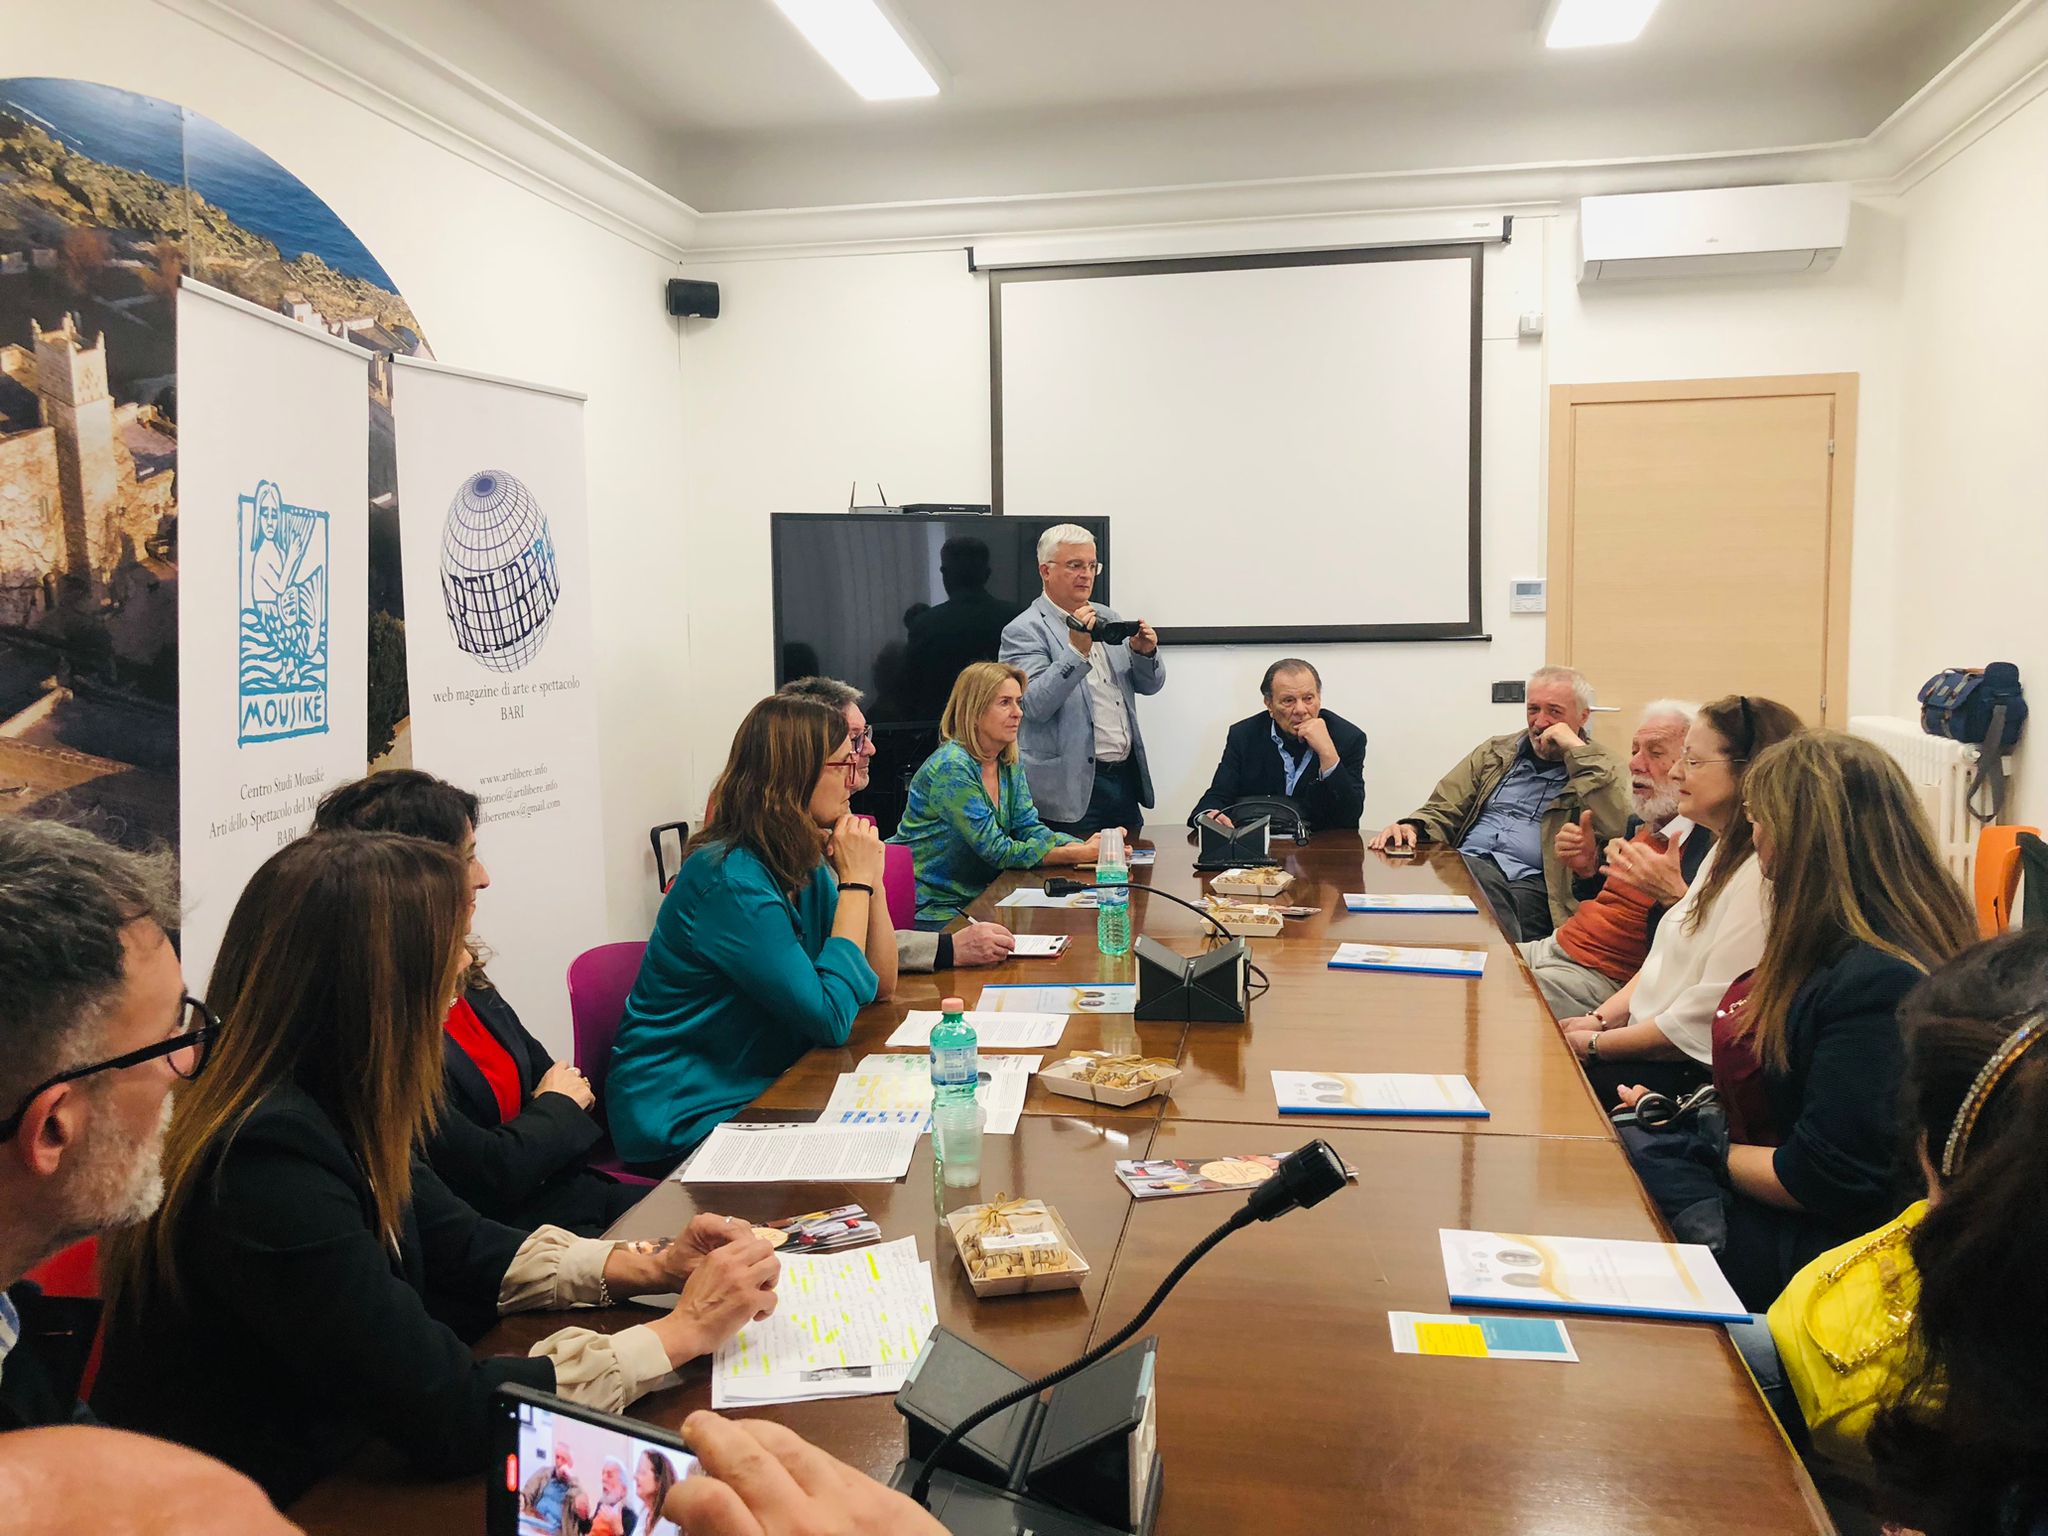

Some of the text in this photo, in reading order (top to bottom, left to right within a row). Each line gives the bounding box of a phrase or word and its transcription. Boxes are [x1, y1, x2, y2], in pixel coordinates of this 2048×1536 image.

[433, 675, 580, 706] web magazine di arte e spettacolo
[500, 705, 525, 721] BARI
[480, 763, 548, 785] www.artilibere.info
[240, 784, 272, 800] Centro
[274, 774, 293, 793] Studi
[209, 820, 227, 839] Arti
[229, 812, 248, 833] dello
[250, 801, 292, 832] Spettacolo
[293, 797, 306, 814] del
[277, 826, 297, 846] BARI
